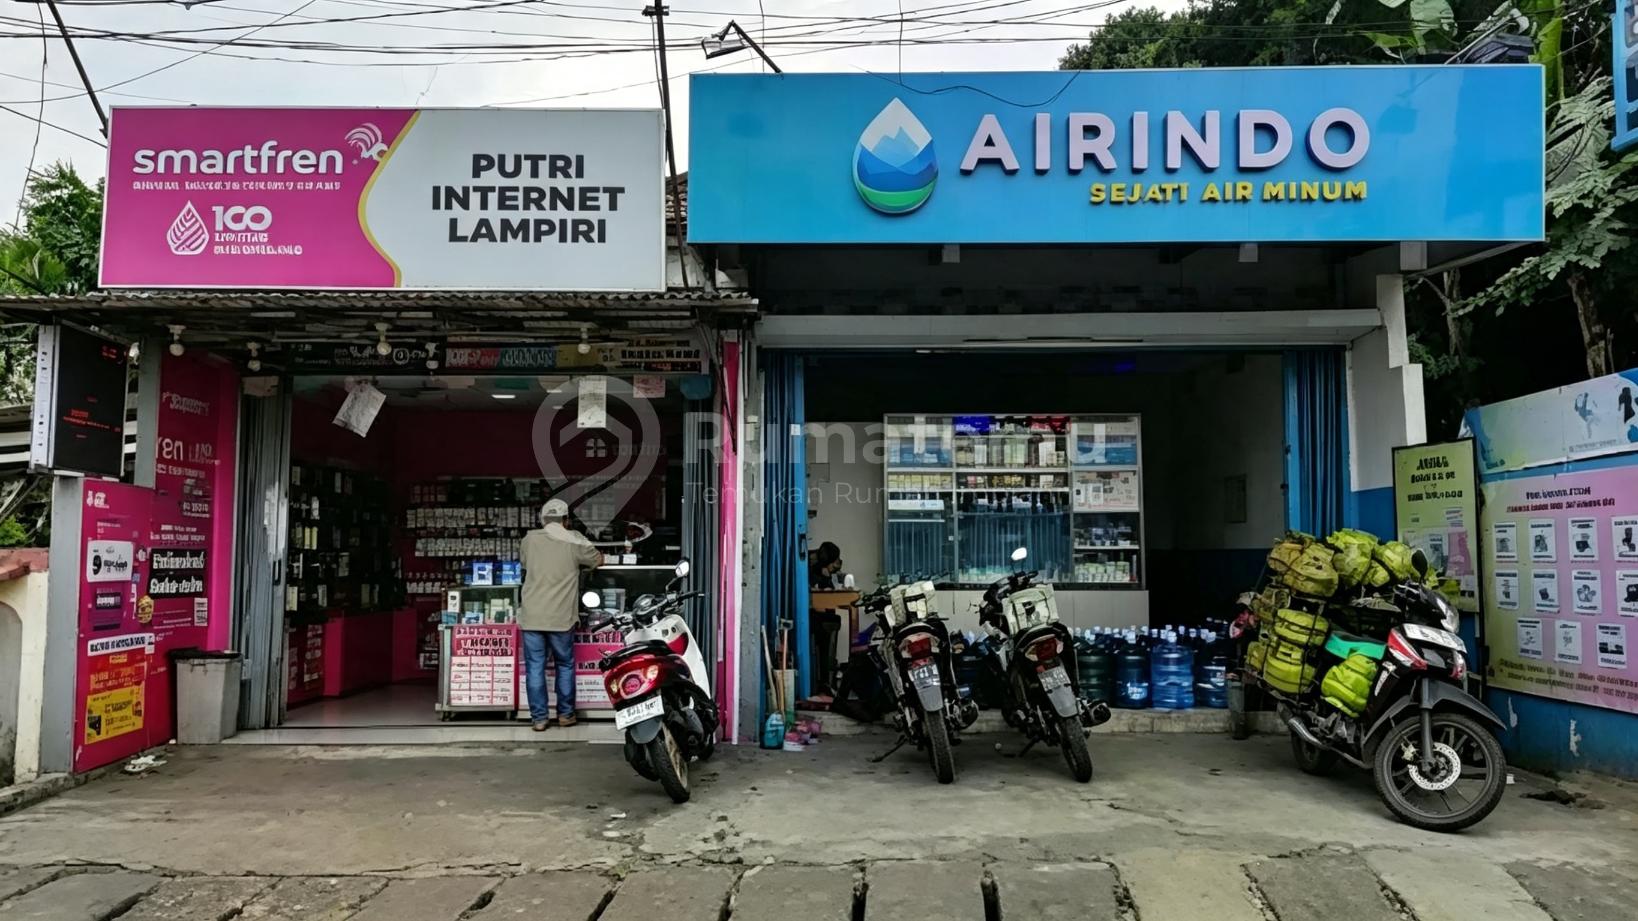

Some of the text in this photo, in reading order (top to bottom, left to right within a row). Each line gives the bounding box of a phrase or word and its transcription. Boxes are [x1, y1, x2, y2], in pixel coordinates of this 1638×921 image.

[960, 107, 1370, 172] AIRINDO
[132, 140, 343, 174] smartfren
[472, 153, 585, 179] PUTRI
[432, 185, 625, 211] INTERNET
[1090, 181, 1367, 203] SEJATI AIR MINUM
[448, 218, 606, 243] LAMPIRI
